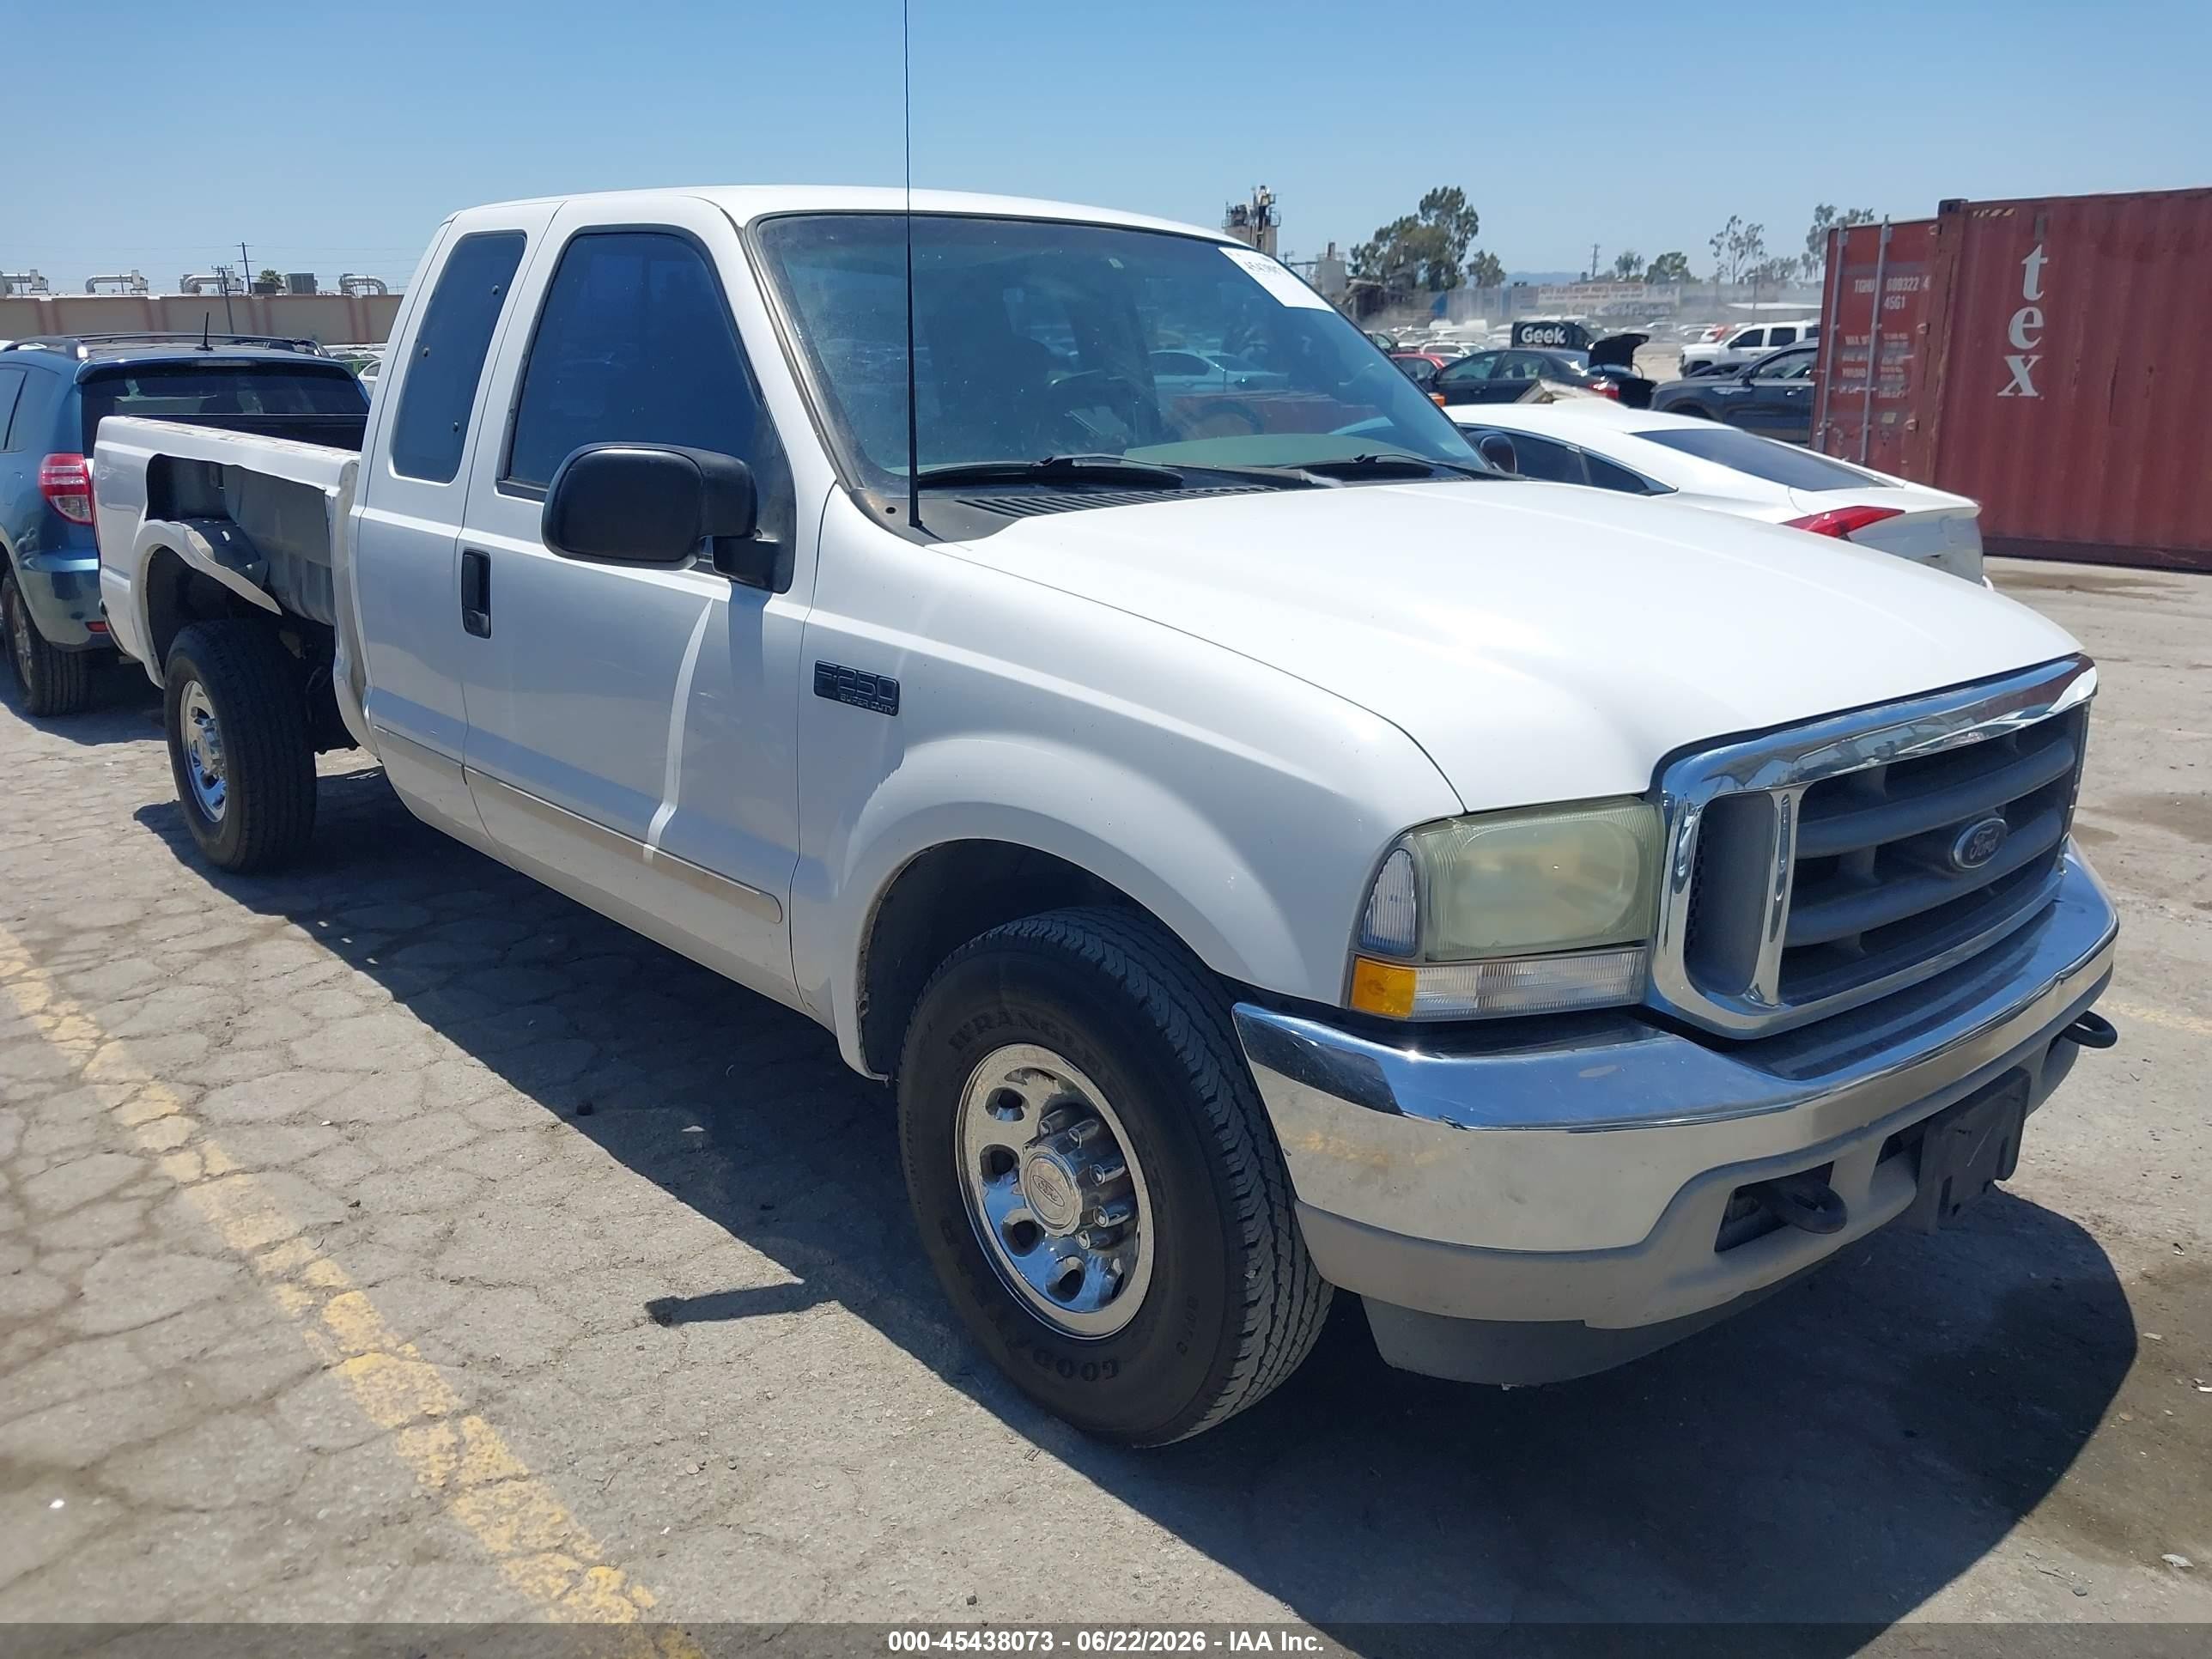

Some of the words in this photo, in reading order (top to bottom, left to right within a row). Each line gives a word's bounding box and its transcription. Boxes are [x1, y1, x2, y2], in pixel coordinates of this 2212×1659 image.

[1996, 244, 2049, 398] tex
[1521, 325, 1566, 344] Geek
[840, 692, 870, 708] SUPER
[871, 700, 895, 715] DUTY
